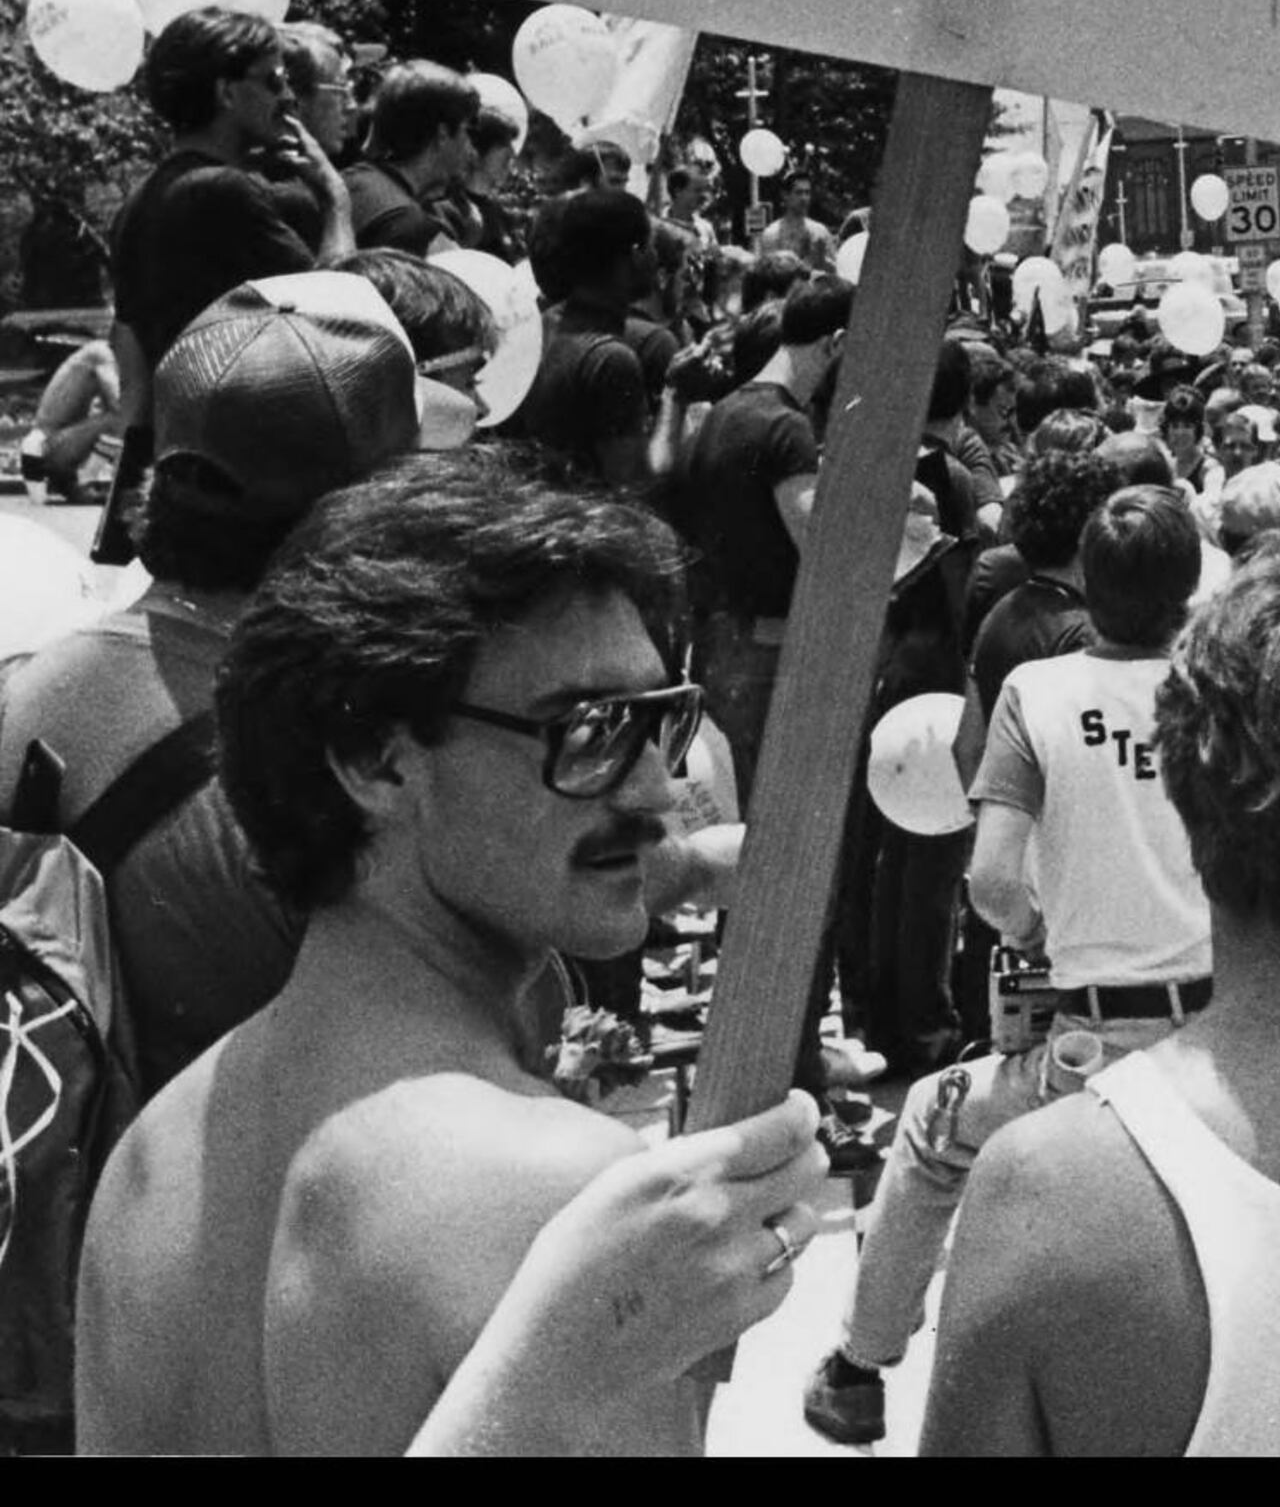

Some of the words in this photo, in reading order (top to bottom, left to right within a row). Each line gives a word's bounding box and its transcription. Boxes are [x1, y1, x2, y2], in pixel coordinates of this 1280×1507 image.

[1227, 173, 1276, 187] SPEED
[1232, 189, 1269, 203] LIMIT
[1230, 205, 1277, 234] 30
